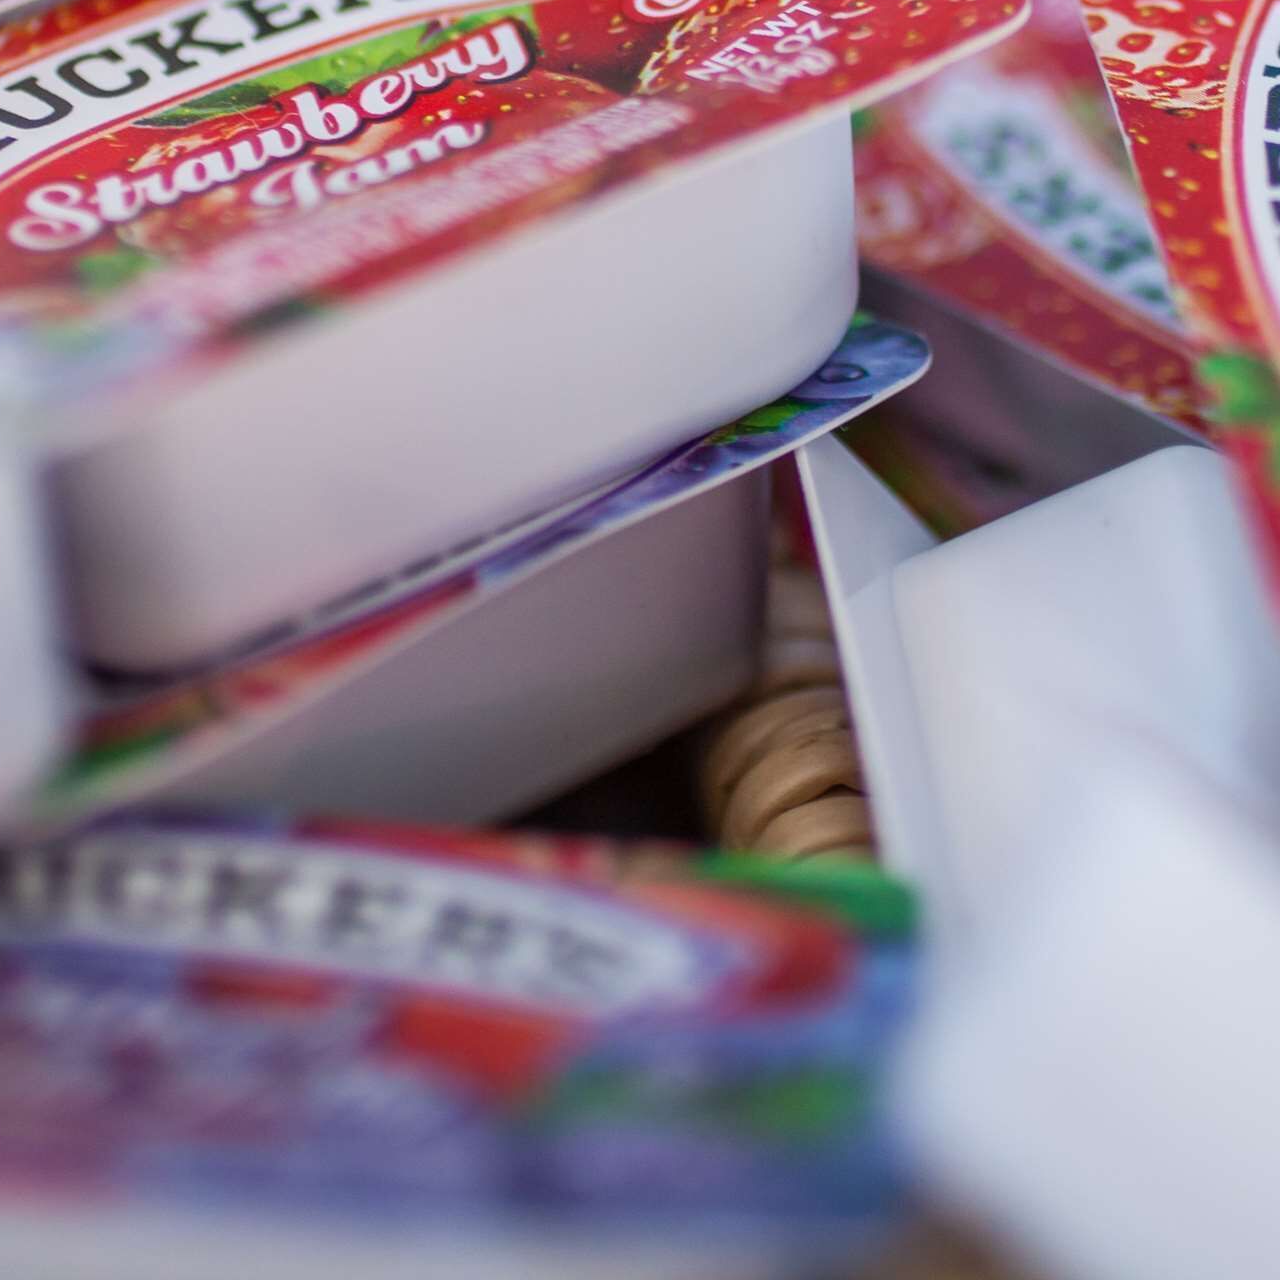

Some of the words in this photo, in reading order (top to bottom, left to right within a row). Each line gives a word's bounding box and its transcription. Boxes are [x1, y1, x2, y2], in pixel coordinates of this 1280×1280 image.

[685, 37, 760, 81] NET
[750, 1, 822, 38] WT
[774, 20, 839, 53] OZ
[9, 22, 529, 252] Strawberry
[250, 118, 487, 208] Jam
